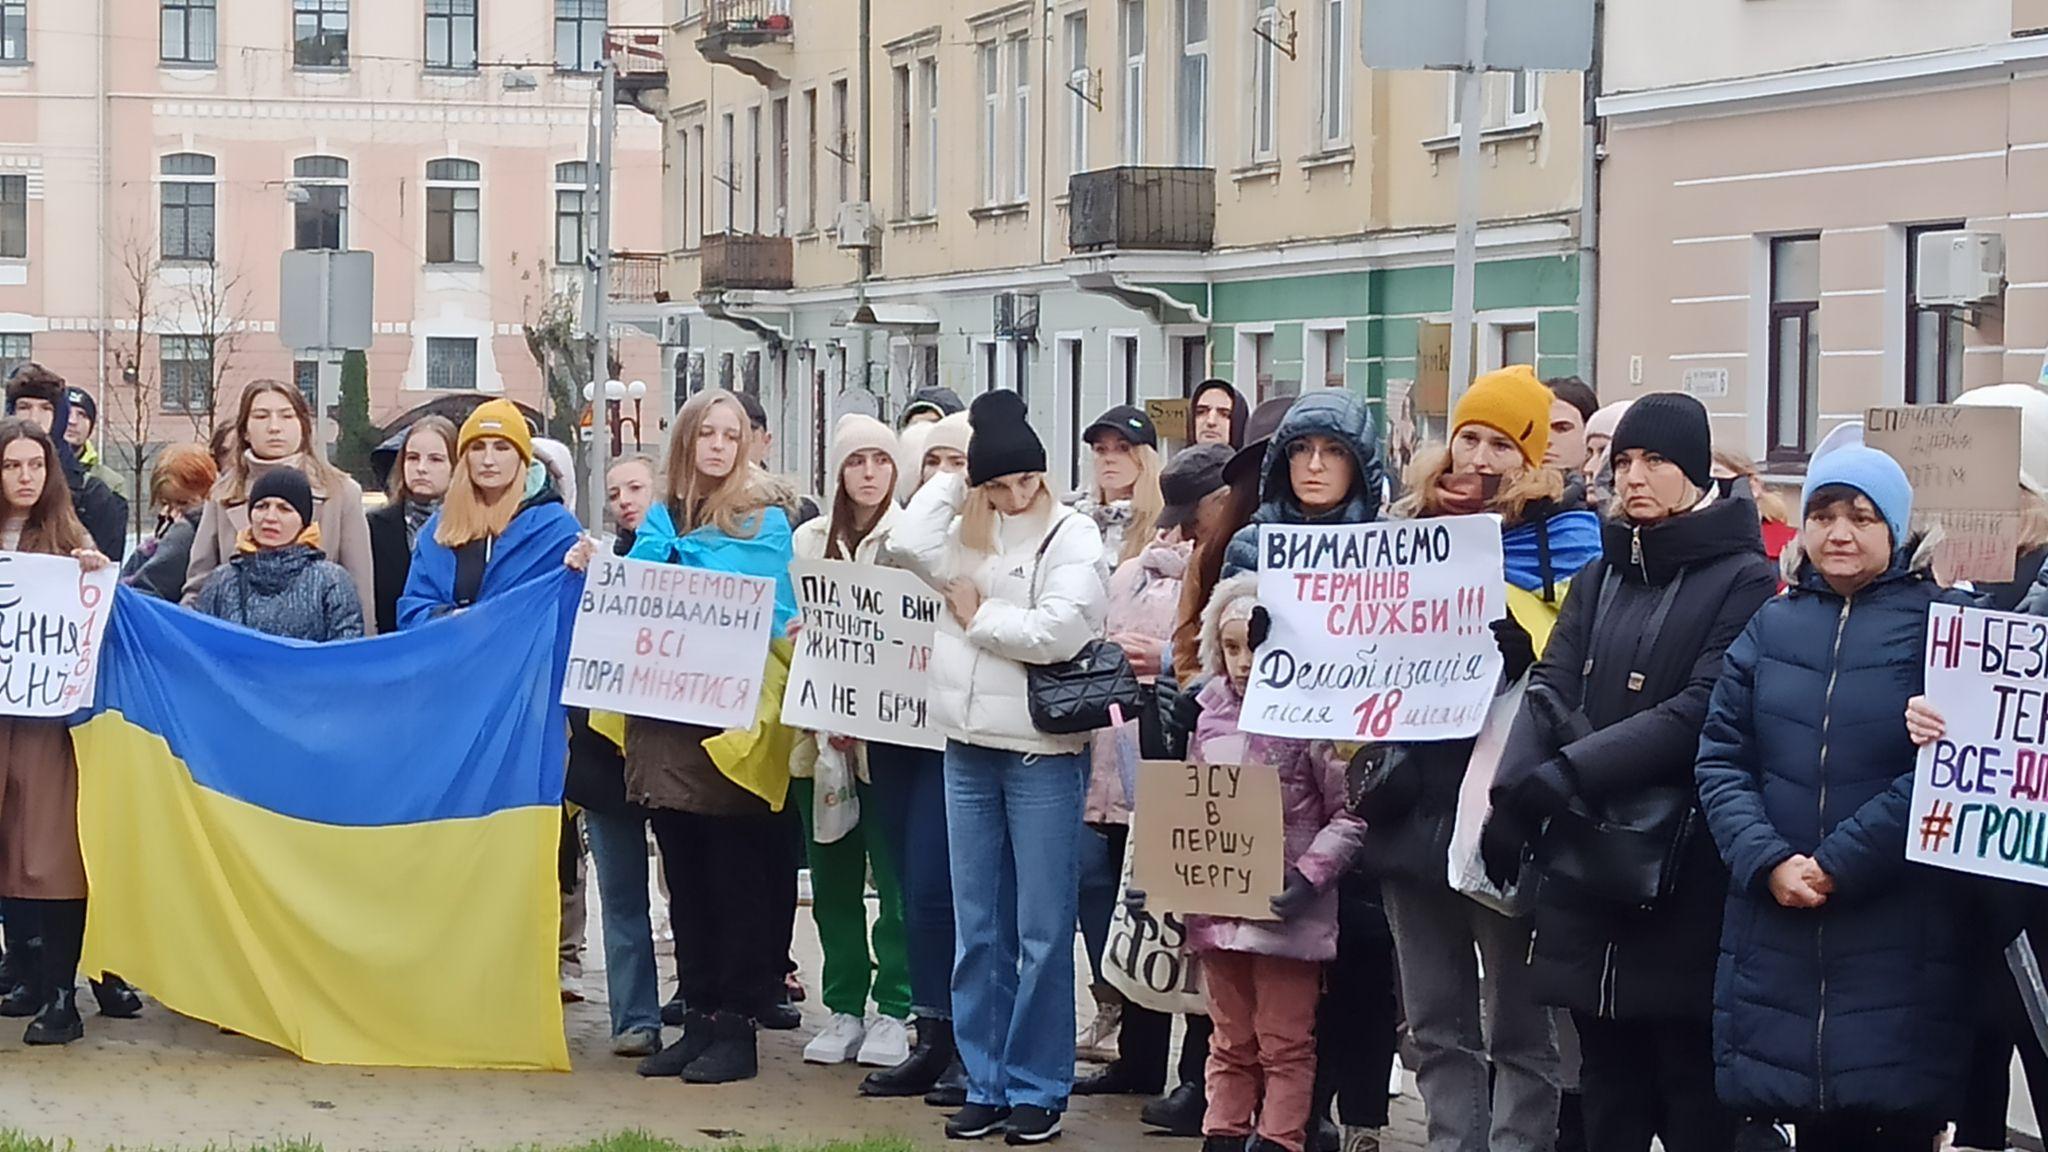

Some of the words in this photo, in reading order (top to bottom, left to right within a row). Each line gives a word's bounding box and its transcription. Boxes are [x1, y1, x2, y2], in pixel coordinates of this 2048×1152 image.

[1267, 525, 1450, 569] ВИМАГАЄМО
[597, 562, 627, 587] ЗА
[641, 568, 767, 605] ПЕРЕМОГУ
[802, 576, 841, 608] ПІД
[851, 584, 884, 615] ЧАС
[1293, 567, 1409, 602] ТЕРМІНІВ
[581, 591, 762, 631] ВІДПОВІДАЛЬНІ
[803, 607, 884, 641] РЯТУЮТЬ
[1327, 599, 1448, 636] СЛУЖБИ
[635, 628, 686, 658] ВСІ
[806, 631, 875, 665] ЖИТТЯ
[1930, 605, 2048, 678] НІ-БЕЗ
[566, 658, 625, 694] ПОРА
[629, 663, 751, 711] МІНЯТИСЯ
[1256, 644, 1485, 691] Демобілізація
[832, 683, 857, 716] НЕ
[1262, 703, 1333, 724] після
[1353, 689, 1402, 738] 18
[1185, 765, 1241, 798] ЗСУ
[1206, 801, 1221, 826] В
[1172, 829, 1255, 856] ПЕРШУ
[1174, 863, 1252, 894] ЧЕРГУ
